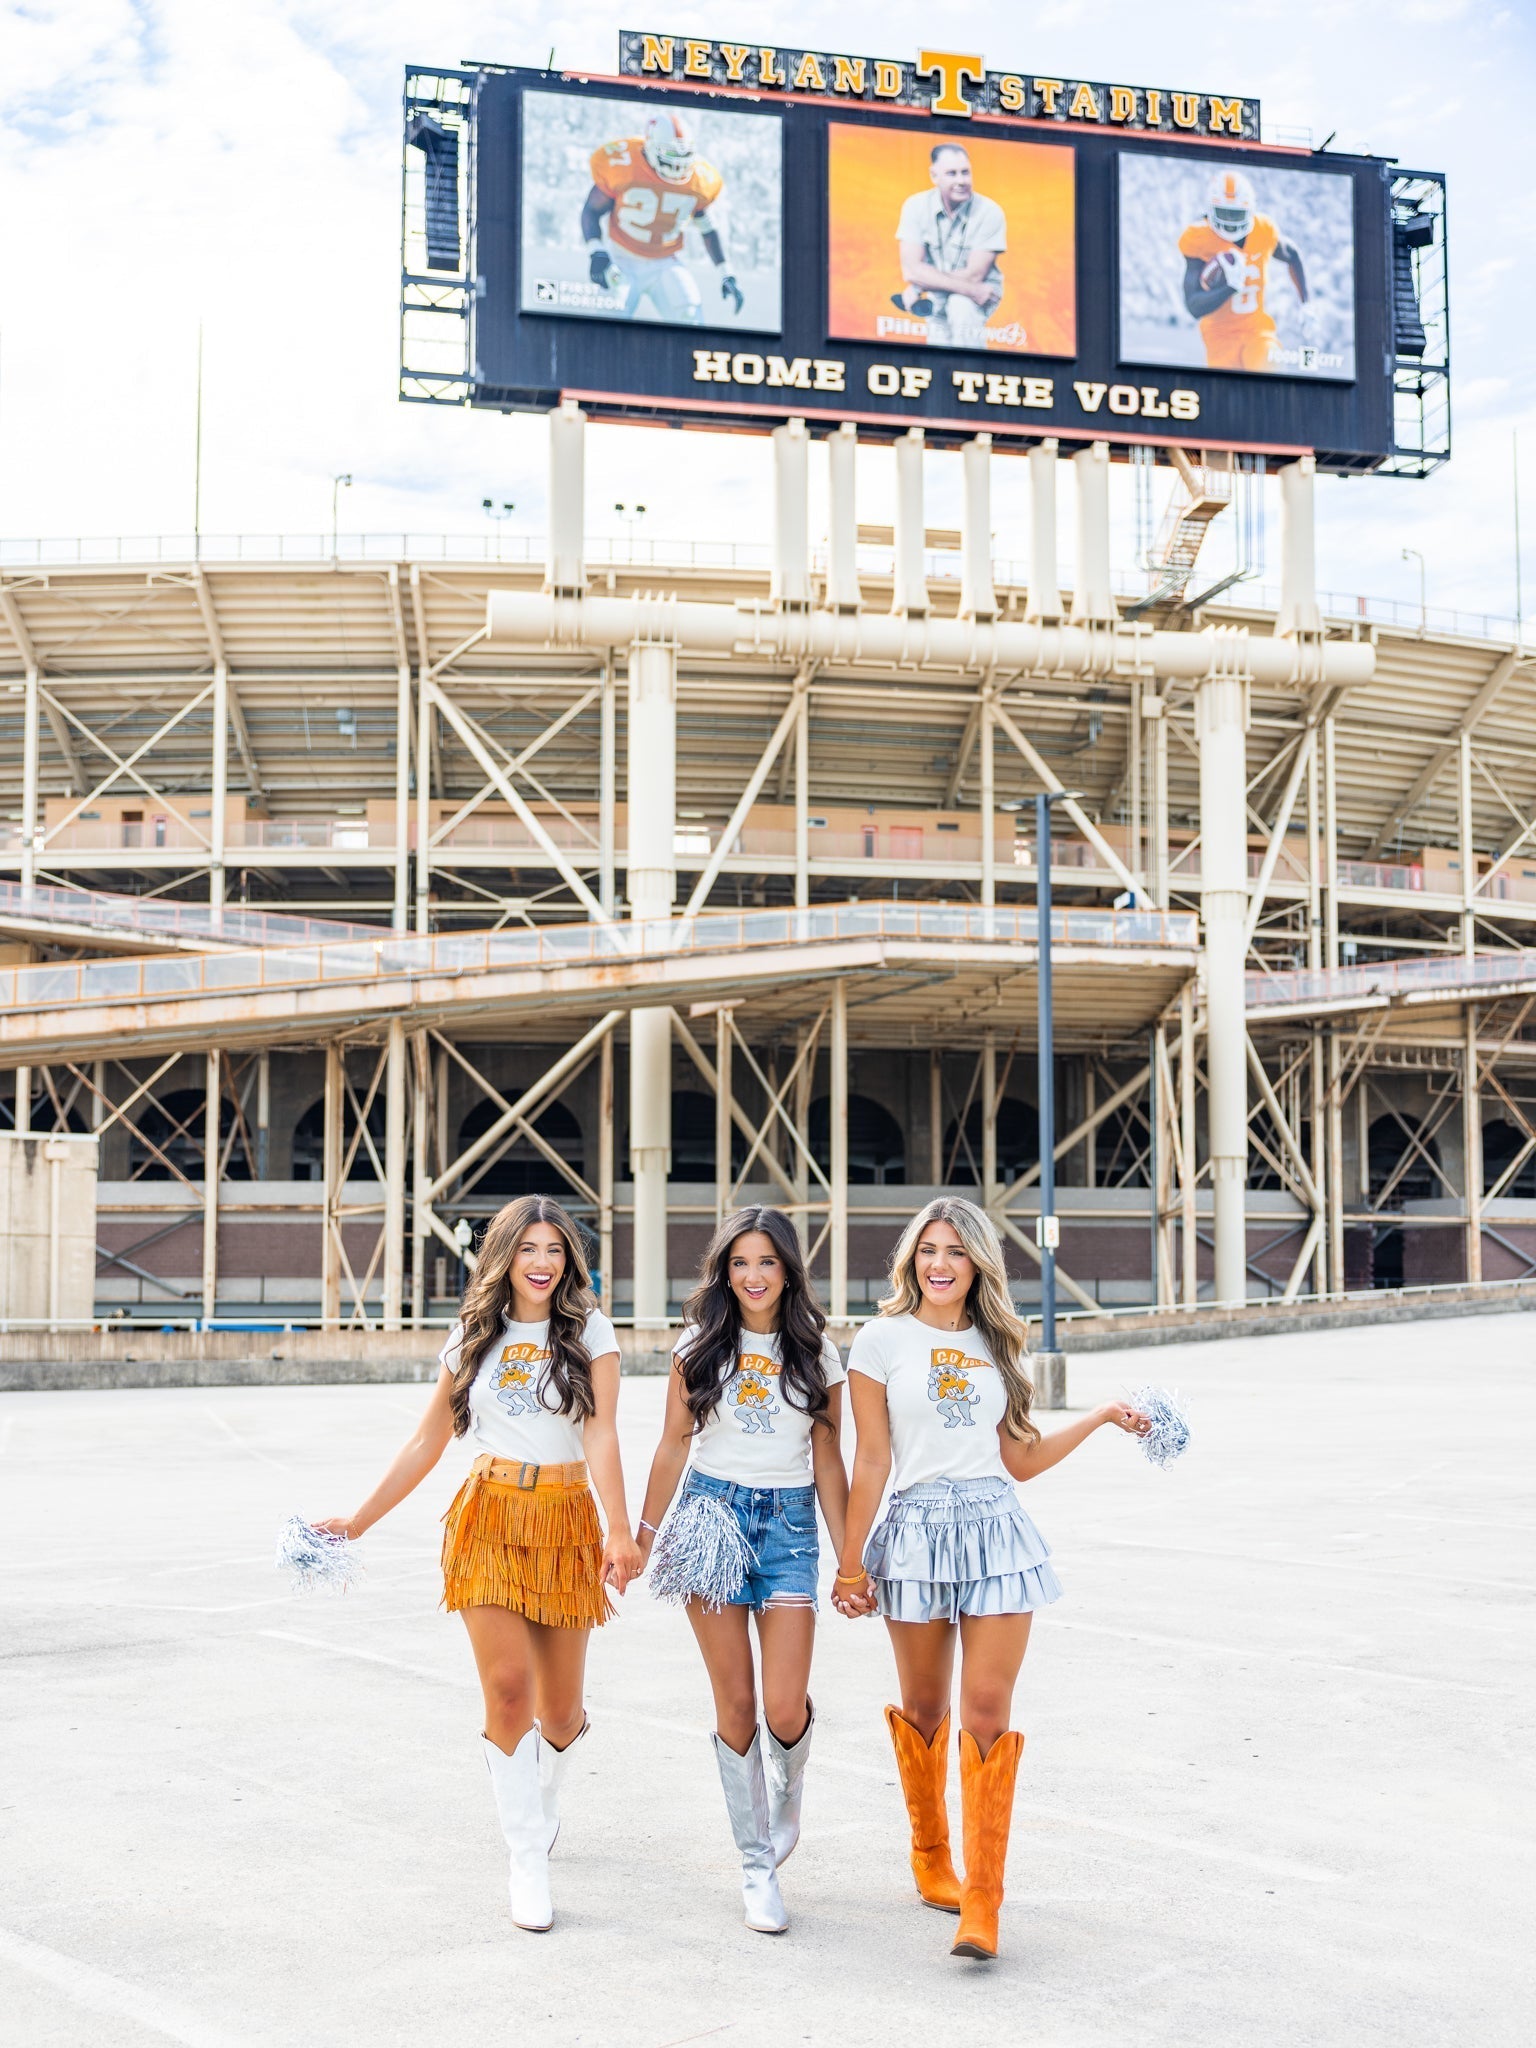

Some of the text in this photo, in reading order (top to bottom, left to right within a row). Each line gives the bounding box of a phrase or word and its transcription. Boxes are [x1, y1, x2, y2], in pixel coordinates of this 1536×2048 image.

[641, 34, 1244, 133] NEYLAND T STADIUM
[617, 187, 698, 243] 27
[560, 294, 624, 310] HORIZON
[692, 350, 1200, 420] HOME OF THE VOLS
[508, 1347, 530, 1360] GO
[936, 1350, 985, 1367] GO VOLS
[743, 1356, 766, 1370] GO
